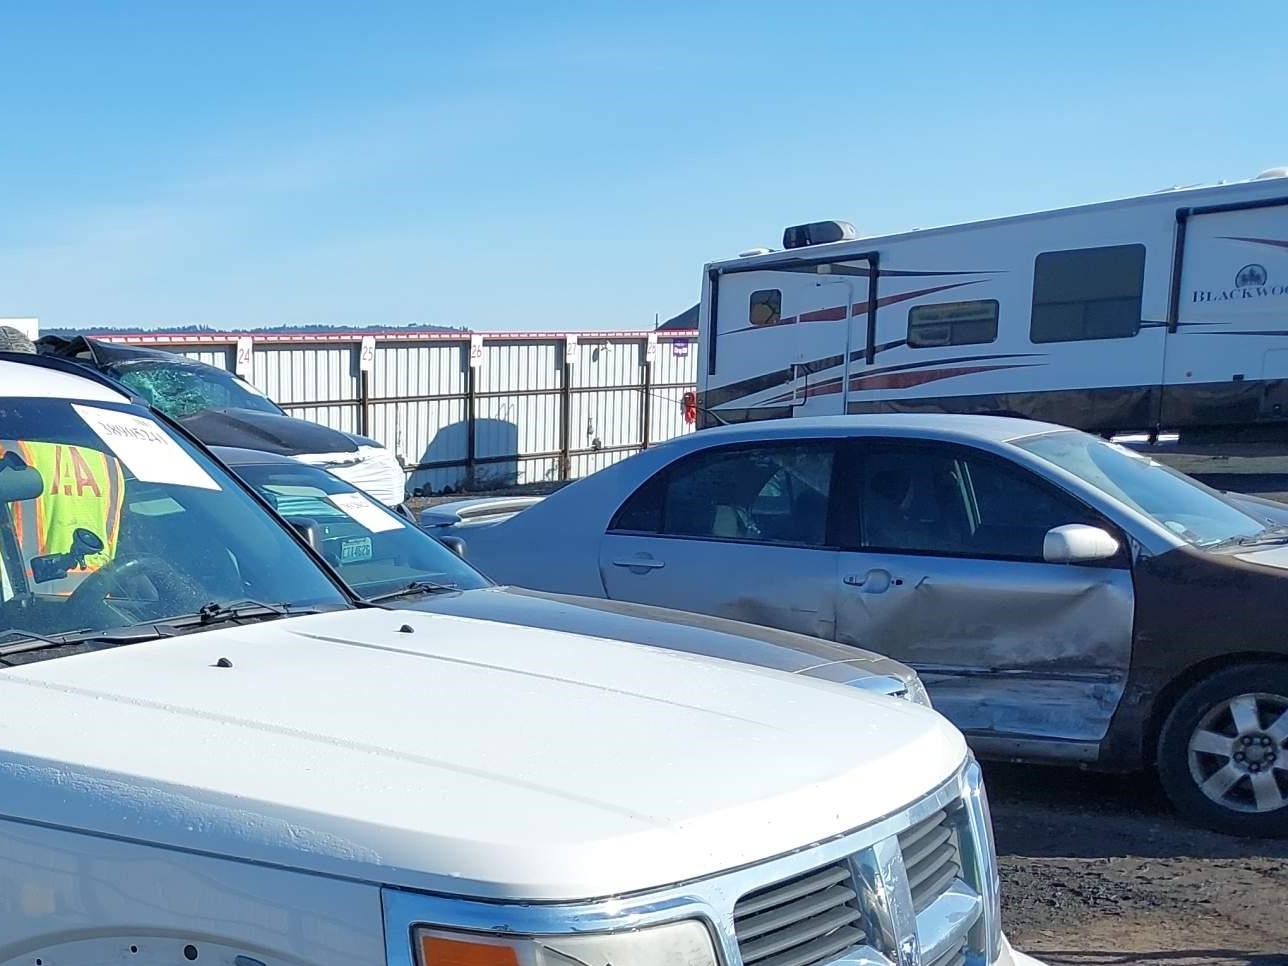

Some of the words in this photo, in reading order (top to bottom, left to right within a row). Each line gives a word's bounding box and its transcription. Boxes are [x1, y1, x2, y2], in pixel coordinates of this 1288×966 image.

[1192, 286, 1288, 303] BLACKWO
[238, 348, 250, 365] 24
[362, 346, 373, 361] 25
[471, 344, 482, 358] 26
